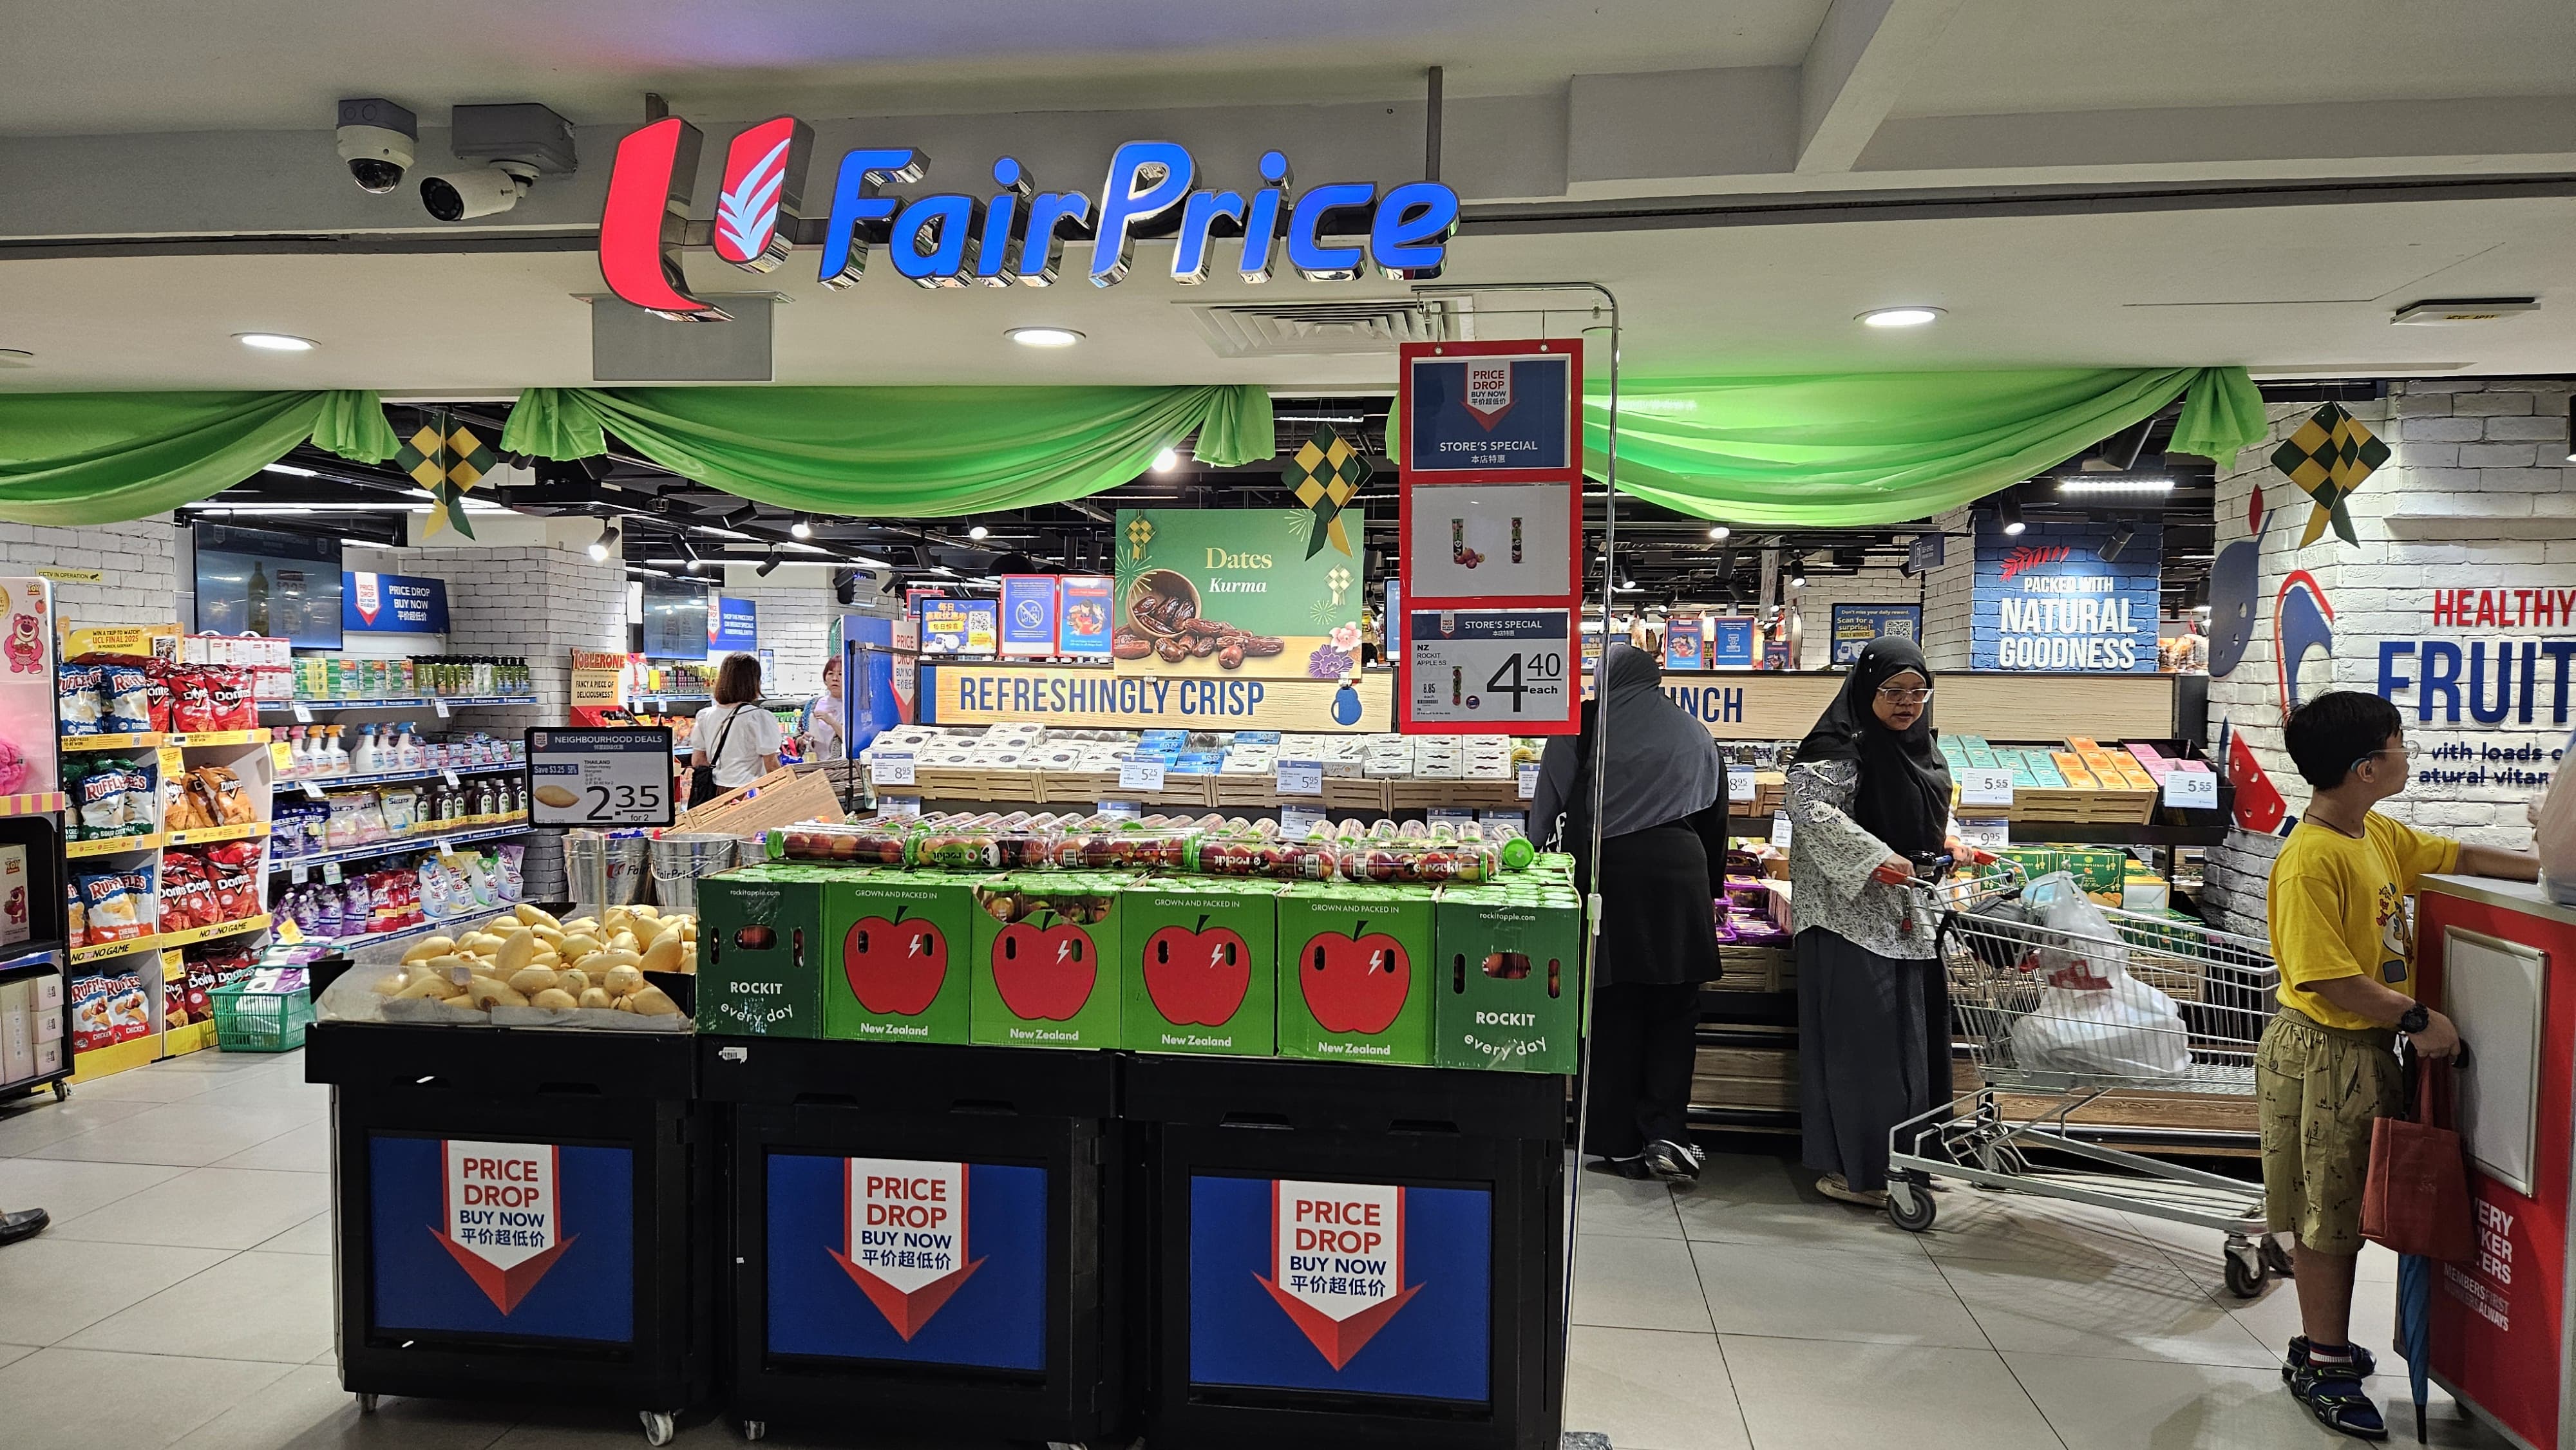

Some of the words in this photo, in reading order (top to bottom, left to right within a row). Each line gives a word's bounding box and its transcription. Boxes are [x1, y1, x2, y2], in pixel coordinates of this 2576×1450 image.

[818, 140, 1460, 288] FairPrice
[1473, 370, 1504, 379] PRICE
[1473, 381, 1504, 390] DROP
[1440, 441, 1487, 451] STORE'S
[1490, 441, 1538, 451] SPECIAL
[1471, 455, 1506, 464] 本店特惠
[1205, 547, 1273, 569] Dates
[389, 585, 410, 595] PRICE
[412, 587, 430, 597] DROP
[1209, 578, 1267, 593] Kurma
[2024, 577, 2075, 593] PACKED
[2079, 577, 2114, 592] WITH
[394, 599, 409, 608] BUY
[410, 600, 428, 609] NOW
[2434, 589, 2576, 626] HEALTHY
[1465, 621, 1502, 629] STORE'S
[2000, 598, 2138, 634] NATURAL
[897, 635, 913, 648] PRICE
[573, 652, 625, 669] TOBLERONE
[1999, 637, 2136, 670] GOODNESS
[1423, 684, 1435, 693] 8.85
[1486, 653, 1528, 712] 4
[1527, 653, 1561, 677] 40
[1530, 686, 1558, 694] each
[2378, 641, 2576, 724] FRUIT
[960, 677, 1170, 714] REFRESHINGLY
[1180, 680, 1264, 715] CRISP
[1662, 687, 1743, 722] NCH
[2482, 742, 2542, 761] loads
[2418, 766, 2485, 784] atural
[587, 786, 659, 820] 2.35
[1213, 855, 1249, 867] rockit
[1425, 861, 1462, 873] rockit
[657, 869, 700, 880] FairPrice
[1203, 899, 1228, 908] PACKED
[1480, 912, 1535, 921] rockitapple.com
[200, 930, 210, 938] NO
[217, 926, 228, 934] NO
[229, 922, 247, 932] GAME
[71, 953, 84, 962] NO
[93, 948, 106, 958] NO
[106, 944, 129, 955] GAME
[730, 982, 783, 995] ROCKIT
[721, 1003, 762, 1026] every
[767, 1003, 793, 1022] day
[1476, 1012, 1535, 1026] ROCKIT
[861, 1022, 885, 1034] New
[886, 1024, 928, 1036] Zealand
[1010, 1028, 1034, 1040] New
[1036, 1029, 1079, 1042] Zealand
[1162, 1034, 1186, 1046] New
[1188, 1035, 1232, 1047] Zealand
[1318, 1042, 1341, 1053] New
[1345, 1042, 1390, 1055] Zealand
[1464, 1034, 1510, 1060] every
[1516, 1037, 1546, 1056] day
[463, 1158, 538, 1182] PRICE
[464, 1184, 539, 1209] DROP
[867, 1176, 946, 1201] PRICE
[460, 1210, 496, 1225] BUY
[499, 1211, 545, 1227] NOW
[867, 1203, 947, 1229] DROP
[1296, 1200, 1380, 1226] PRICE
[2475, 1196, 2514, 1237] ERY
[460, 1227, 545, 1248] 平价超低价
[861, 1230, 898, 1248] BUY
[904, 1232, 952, 1250] NOW
[1296, 1229, 1381, 1254] DROP
[2477, 1225, 2512, 1263] KER
[861, 1248, 952, 1271] 平价超低价
[1290, 1256, 1329, 1272] BUY
[1335, 1258, 1387, 1274] NOW
[2477, 1250, 2511, 1285] ERS
[1290, 1275, 1387, 1297] 平价超低价
